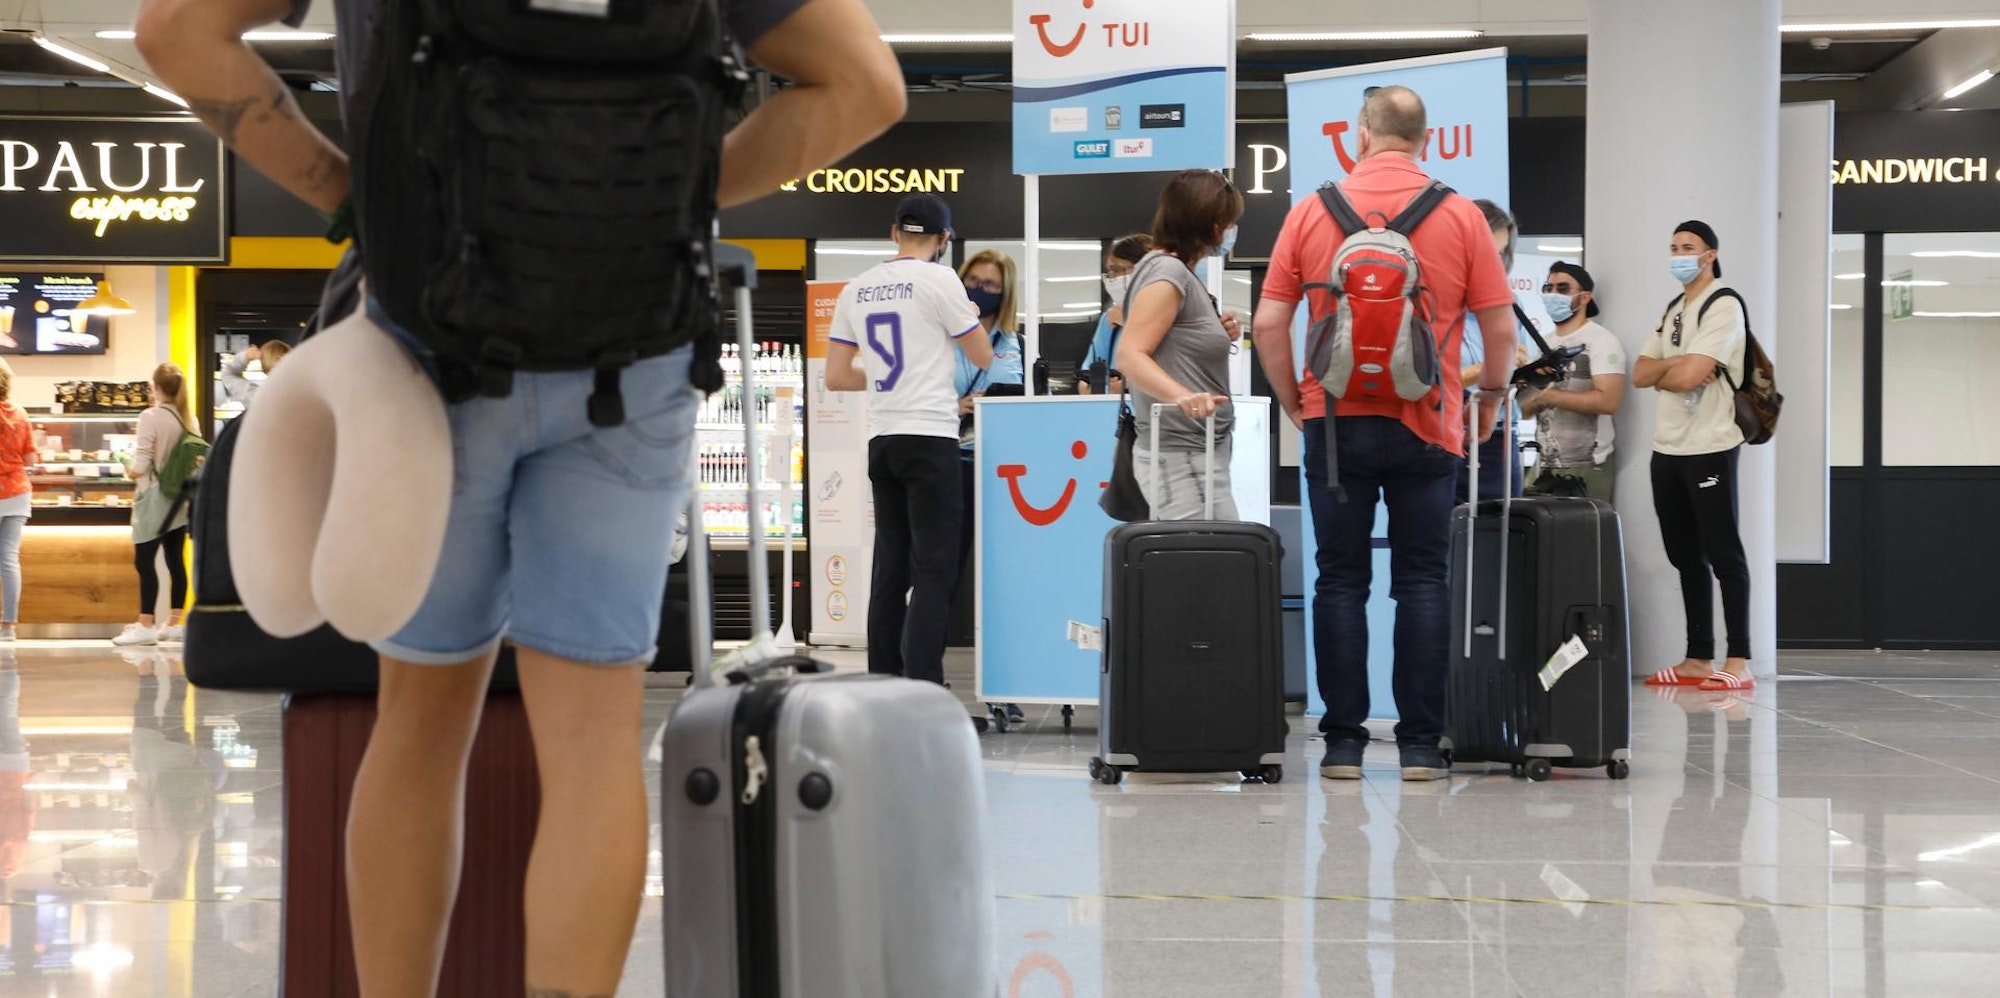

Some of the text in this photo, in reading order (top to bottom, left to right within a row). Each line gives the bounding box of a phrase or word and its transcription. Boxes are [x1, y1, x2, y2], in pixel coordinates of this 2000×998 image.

[1102, 22, 1149, 48] TUI
[1076, 143, 1108, 154] GULET
[0, 140, 205, 192] PAUL
[1830, 157, 1988, 184] SANDWICH
[806, 168, 965, 193] CROISSANT
[70, 194, 197, 238] express
[857, 283, 913, 303] BENZEMA
[866, 311, 905, 392] 9
